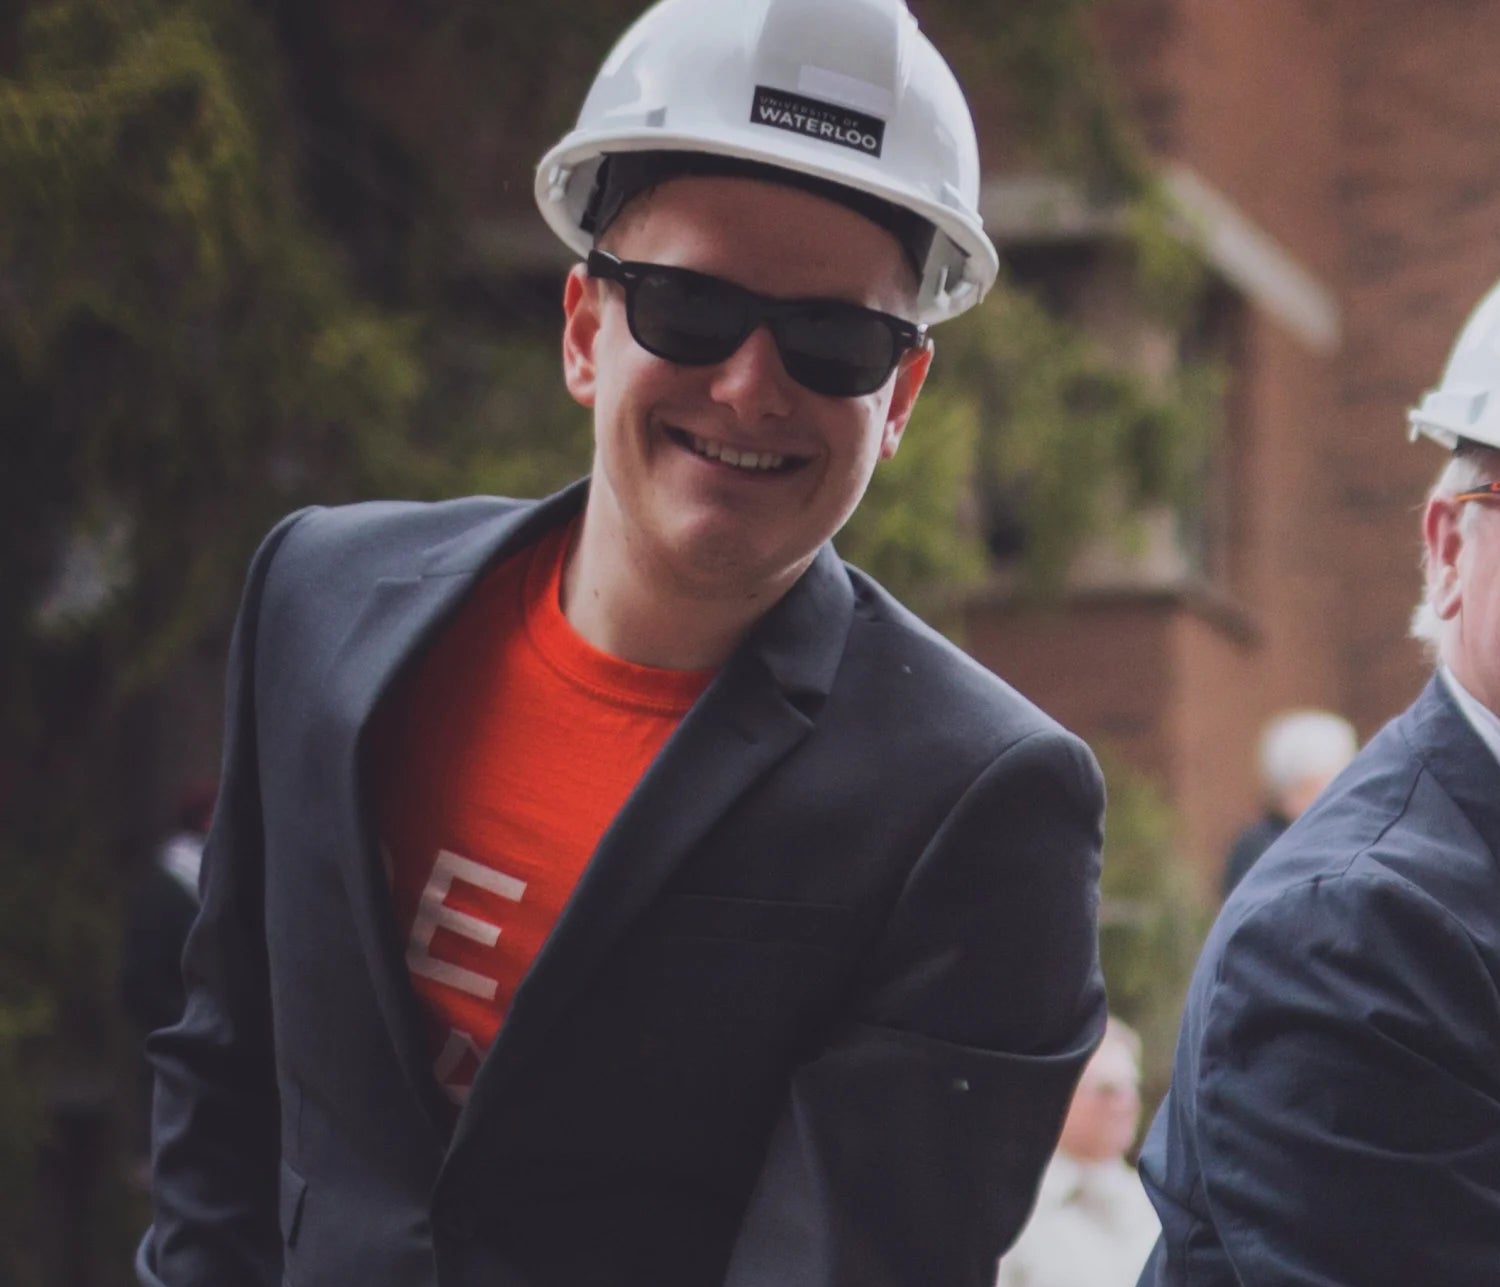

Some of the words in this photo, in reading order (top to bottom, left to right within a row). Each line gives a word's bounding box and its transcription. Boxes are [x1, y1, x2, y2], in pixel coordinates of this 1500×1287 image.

[759, 95, 838, 122] UNIVERSITY
[843, 117, 859, 128] OF
[759, 105, 877, 150] WATERLOO
[378, 834, 528, 1001] E
